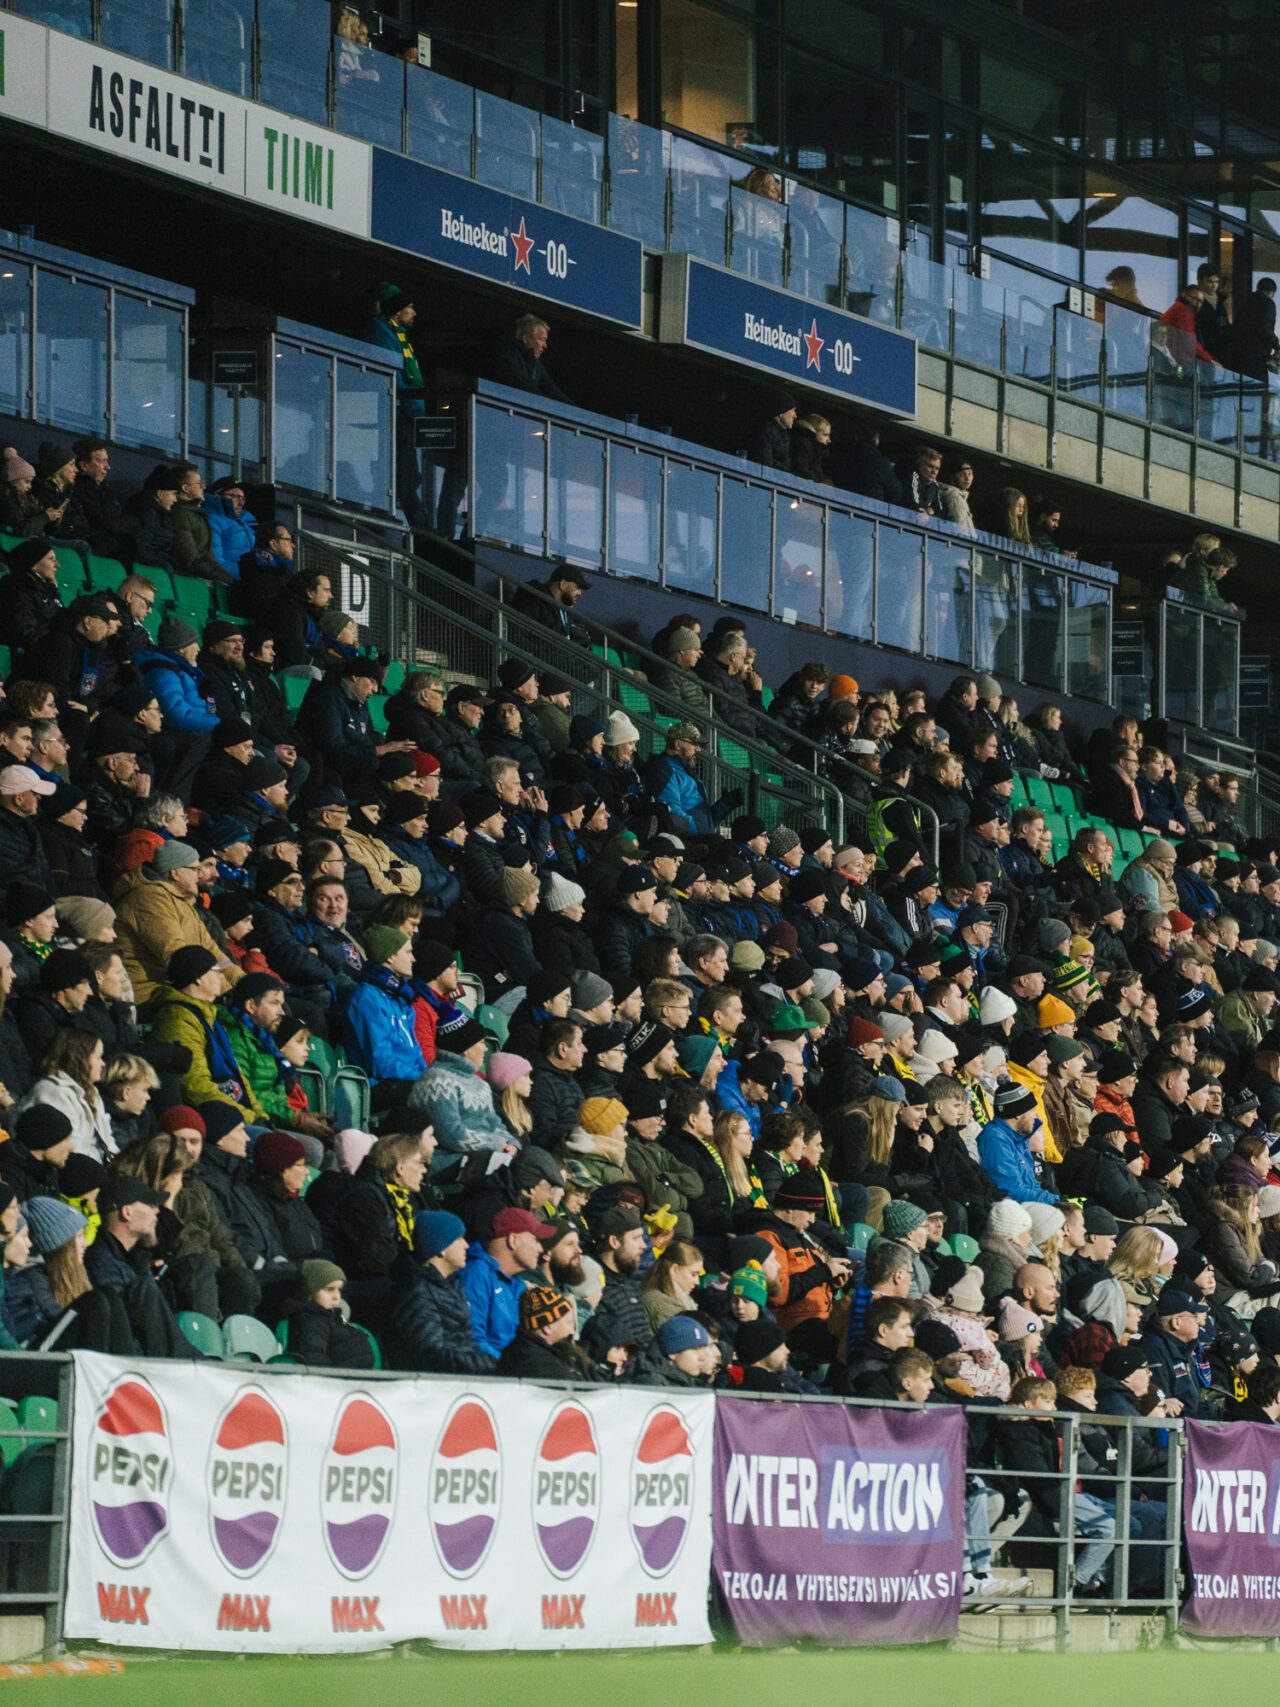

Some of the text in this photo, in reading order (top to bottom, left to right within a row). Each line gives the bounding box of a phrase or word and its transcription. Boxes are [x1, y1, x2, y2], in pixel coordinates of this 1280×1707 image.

[264, 127, 334, 210] TIIMI
[441, 208, 508, 257] Heineken
[744, 312, 801, 357] Heineken
[349, 568, 365, 612] D
[94, 1443, 169, 1493] PEPSI
[213, 1460, 282, 1501] PEPSI
[326, 1466, 393, 1504] PEPSI
[434, 1468, 497, 1504] PEPSI
[536, 1471, 596, 1506] PEPSI
[634, 1473, 688, 1506] PEPSI
[725, 1453, 943, 1532] INTER ACTION
[1191, 1468, 1267, 1534] INTER
[97, 1582, 151, 1625] MAX
[722, 1571, 787, 1600] TEKOJA
[796, 1573, 878, 1603] YHTEISEKSI
[217, 1593, 271, 1632] MAX
[331, 1596, 385, 1632] MAX
[439, 1594, 487, 1630] MAX
[541, 1594, 586, 1629] MAX
[635, 1592, 678, 1627] MAX
